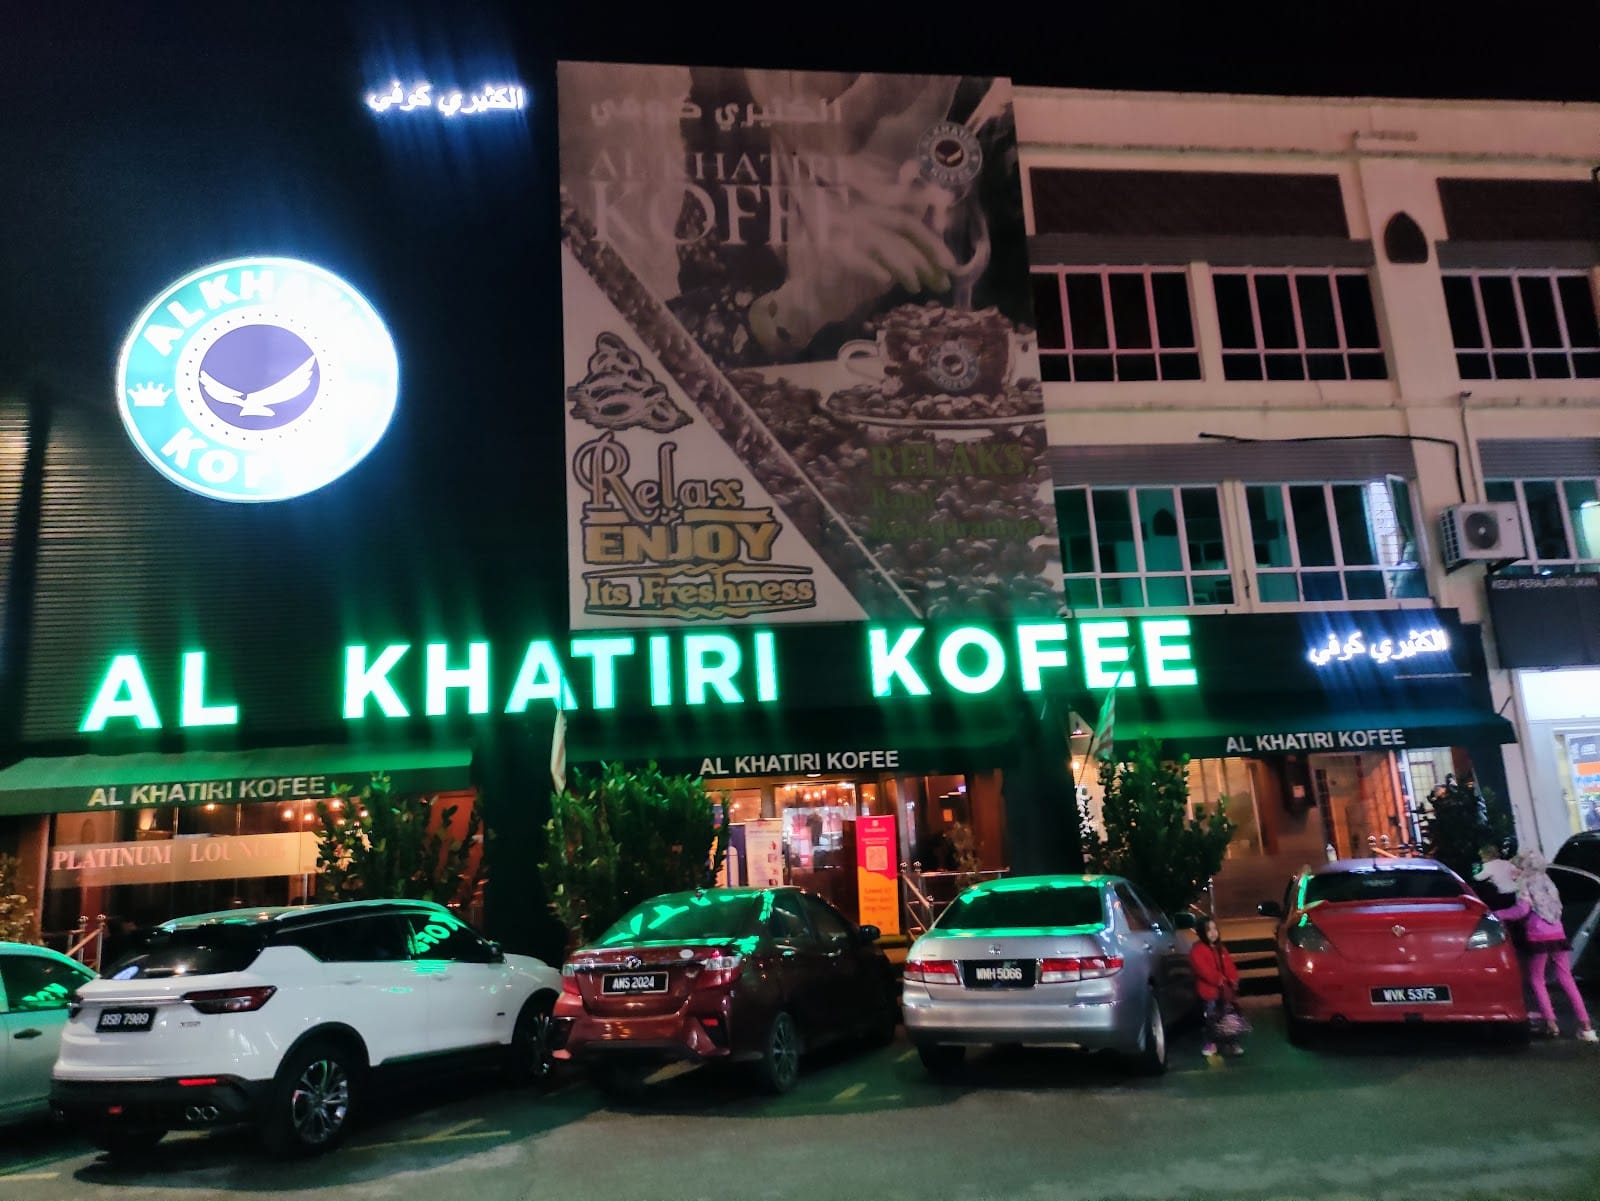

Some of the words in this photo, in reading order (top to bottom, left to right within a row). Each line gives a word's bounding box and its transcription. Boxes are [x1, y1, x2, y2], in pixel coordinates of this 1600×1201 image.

[369, 81, 432, 112] كوفي
[572, 432, 745, 524] Relax
[583, 523, 783, 565] ENJOY
[585, 574, 632, 608] Its
[639, 569, 817, 608] Freshness
[78, 651, 240, 733] AL
[342, 631, 778, 720] KHATIRI
[867, 619, 1199, 698] KOFEE
[1226, 736, 1252, 753] AL
[1256, 732, 1334, 751] KHATIRI
[1338, 729, 1406, 748] KOFEE
[700, 757, 729, 775] AL
[735, 753, 821, 774] KHATIRI
[827, 750, 900, 770] KOFEE
[87, 787, 124, 807] AL
[130, 781, 232, 805] KHATIRI
[239, 776, 325, 798] KOFEE
[51, 844, 172, 871] PLATINUM
[189, 840, 286, 863] LOUN
[631, 976, 655, 989] 2024
[976, 968, 996, 980] WMH
[1383, 989, 1405, 1001] WVK
[1407, 987, 1436, 1001] 5375
